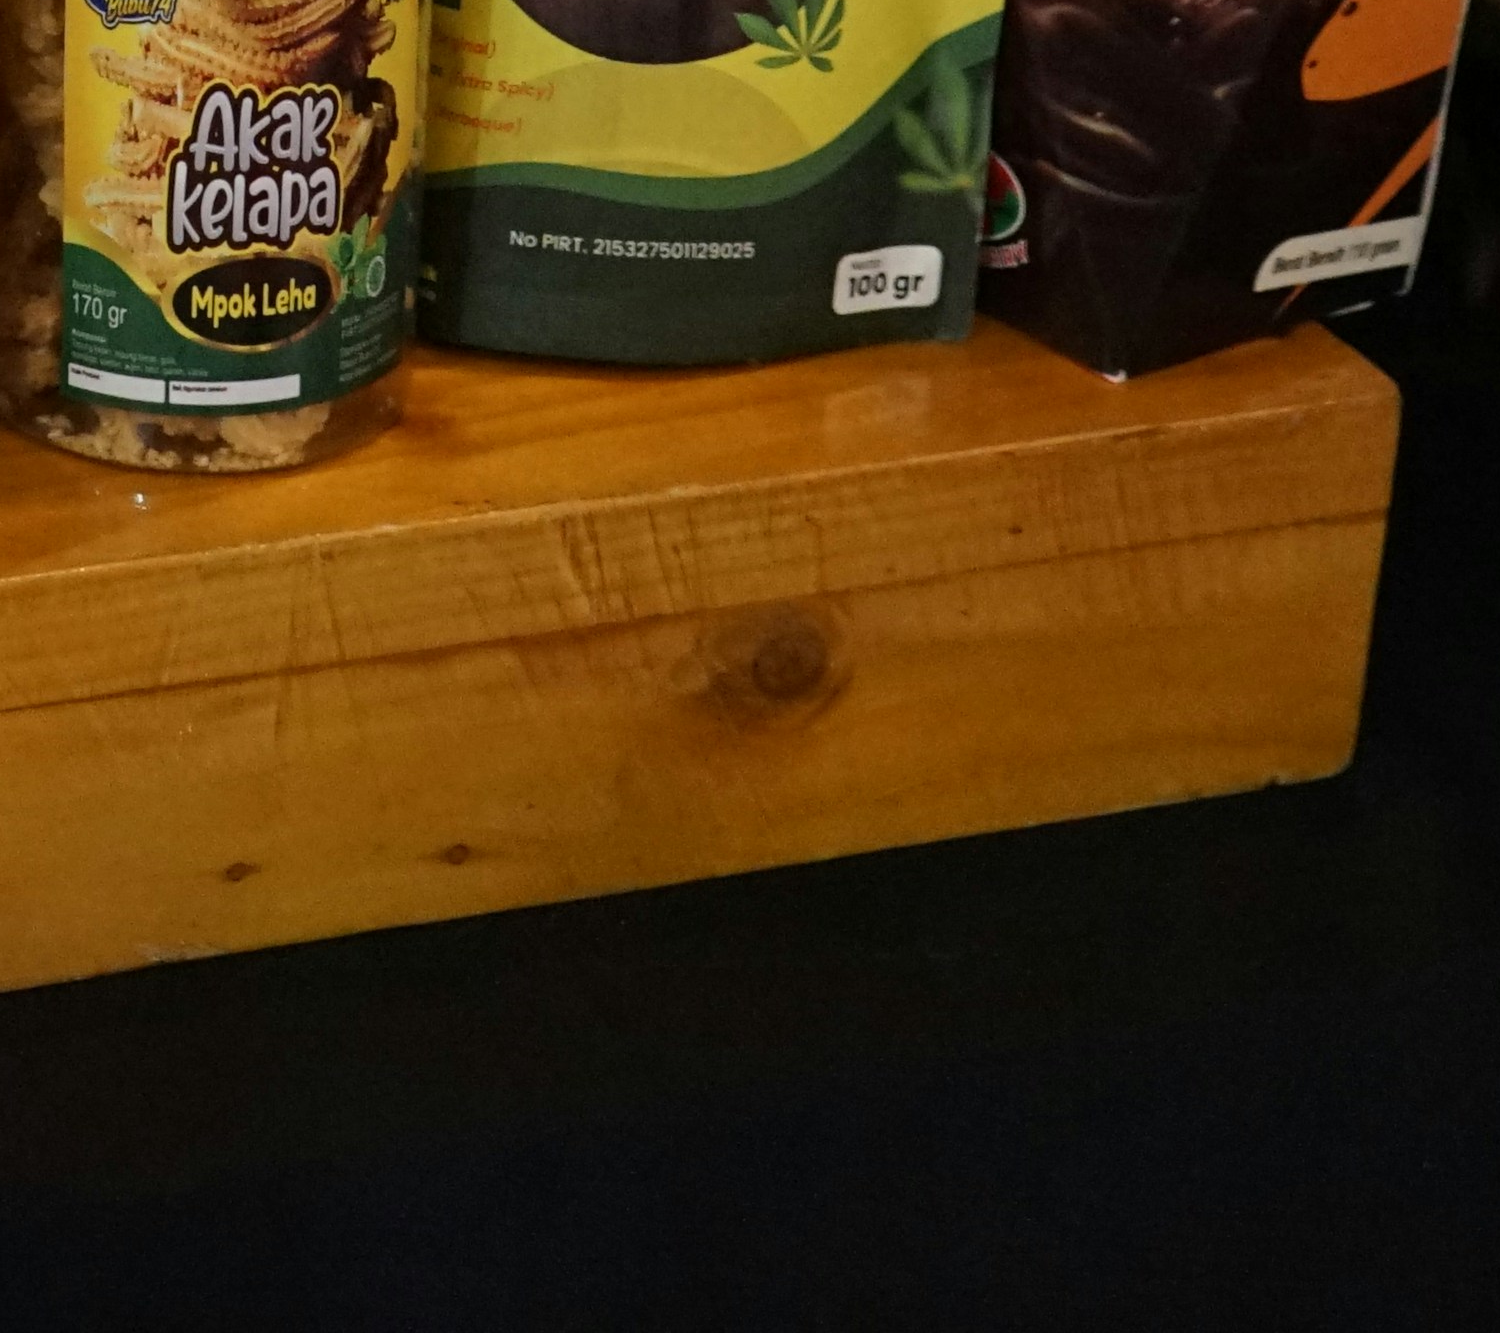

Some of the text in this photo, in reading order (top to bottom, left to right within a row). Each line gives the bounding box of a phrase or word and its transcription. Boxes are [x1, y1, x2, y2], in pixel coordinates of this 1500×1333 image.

[172, 160, 339, 247] kelapa
[508, 230, 538, 249] No
[541, 233, 588, 255] PIRT.
[190, 279, 317, 329] Mpok Leha
[847, 272, 926, 300] 100 gr
[72, 292, 128, 329] 170 gr
